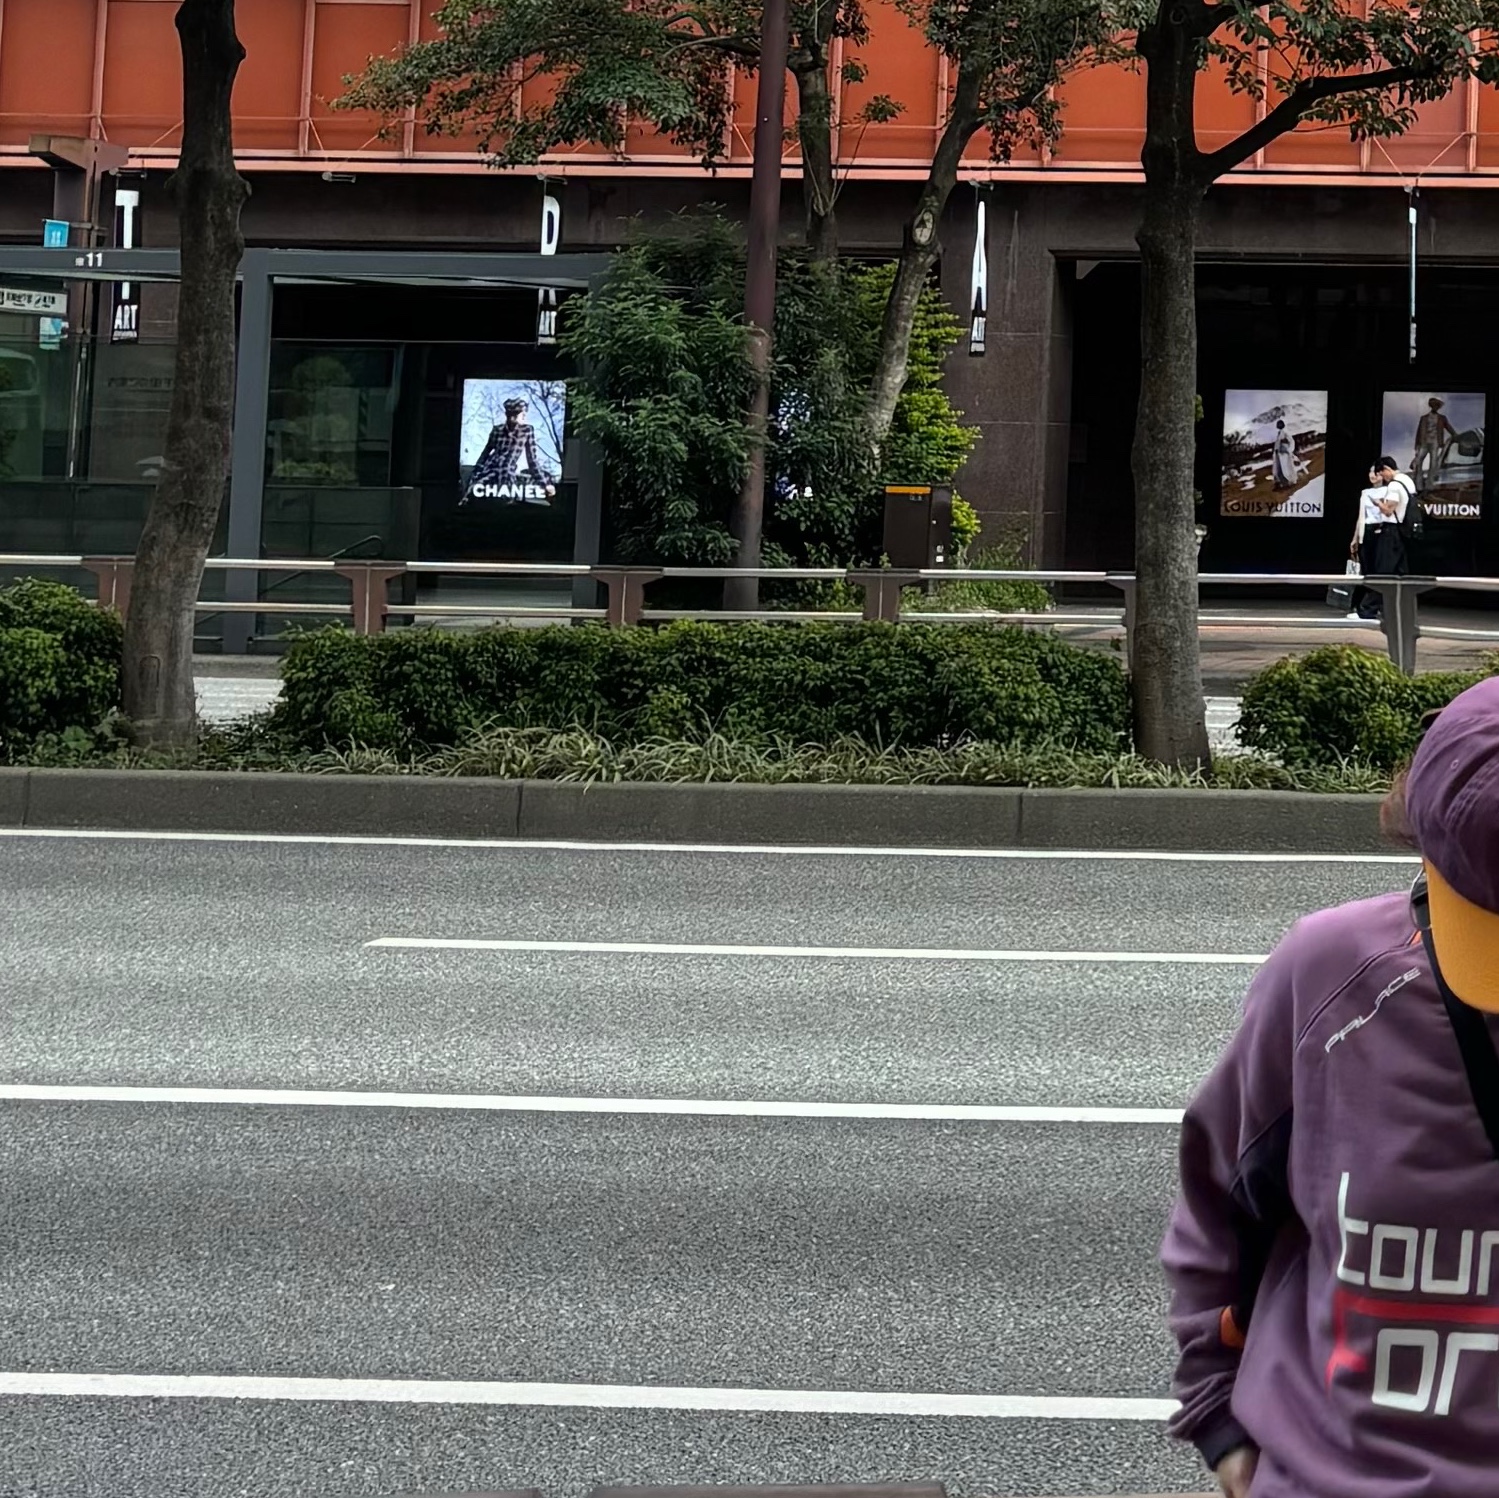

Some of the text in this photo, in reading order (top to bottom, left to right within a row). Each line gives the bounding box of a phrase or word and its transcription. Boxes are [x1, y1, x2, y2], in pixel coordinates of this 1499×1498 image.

[114, 304, 138, 329] ART
[473, 483, 546, 500] CHANEL
[1224, 500, 1321, 513] LOUIS VUITTON
[1424, 503, 1480, 516] VUITTON
[1325, 966, 1421, 1053] PALACE
